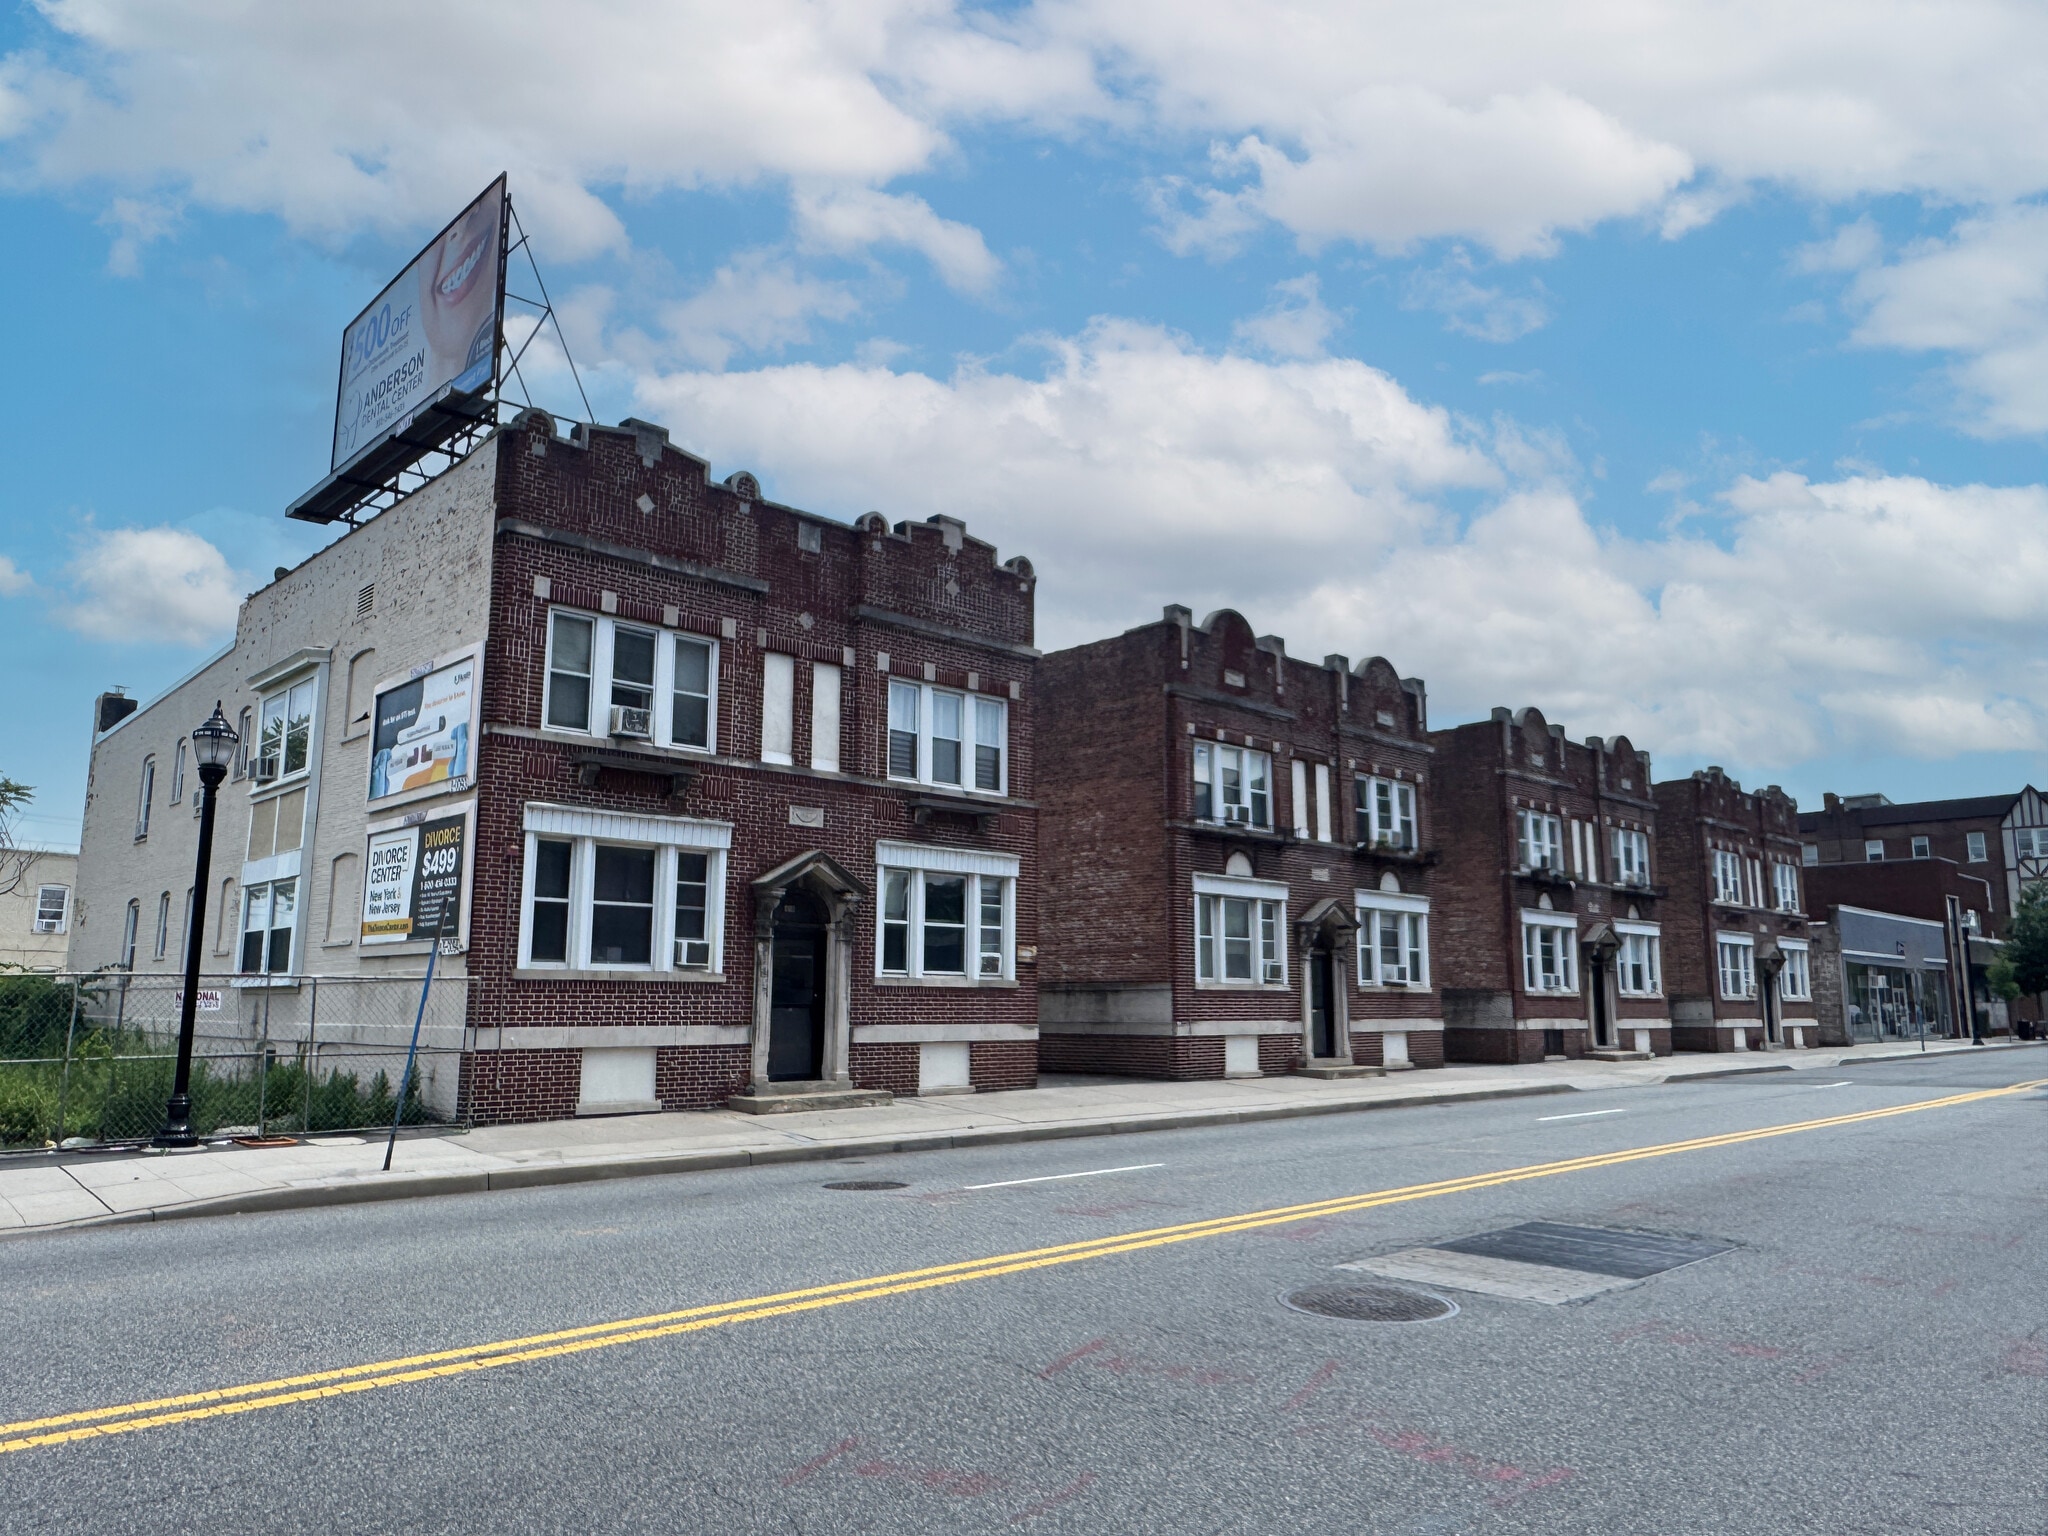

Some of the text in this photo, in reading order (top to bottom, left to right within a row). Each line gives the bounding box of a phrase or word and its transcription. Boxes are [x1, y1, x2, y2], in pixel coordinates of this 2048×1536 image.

[391, 305, 412, 336] OFF
[363, 348, 424, 412] ANDERSON
[361, 397, 390, 428] DENTAL
[392, 371, 423, 404] CENTER
[425, 826, 461, 848] DIVORCE
[372, 846, 408, 867] DIVORCE
[371, 865, 402, 884] CENTER
[370, 890, 382, 901] New
[384, 888, 396, 900] York
[369, 902, 401, 916] New Jersey
